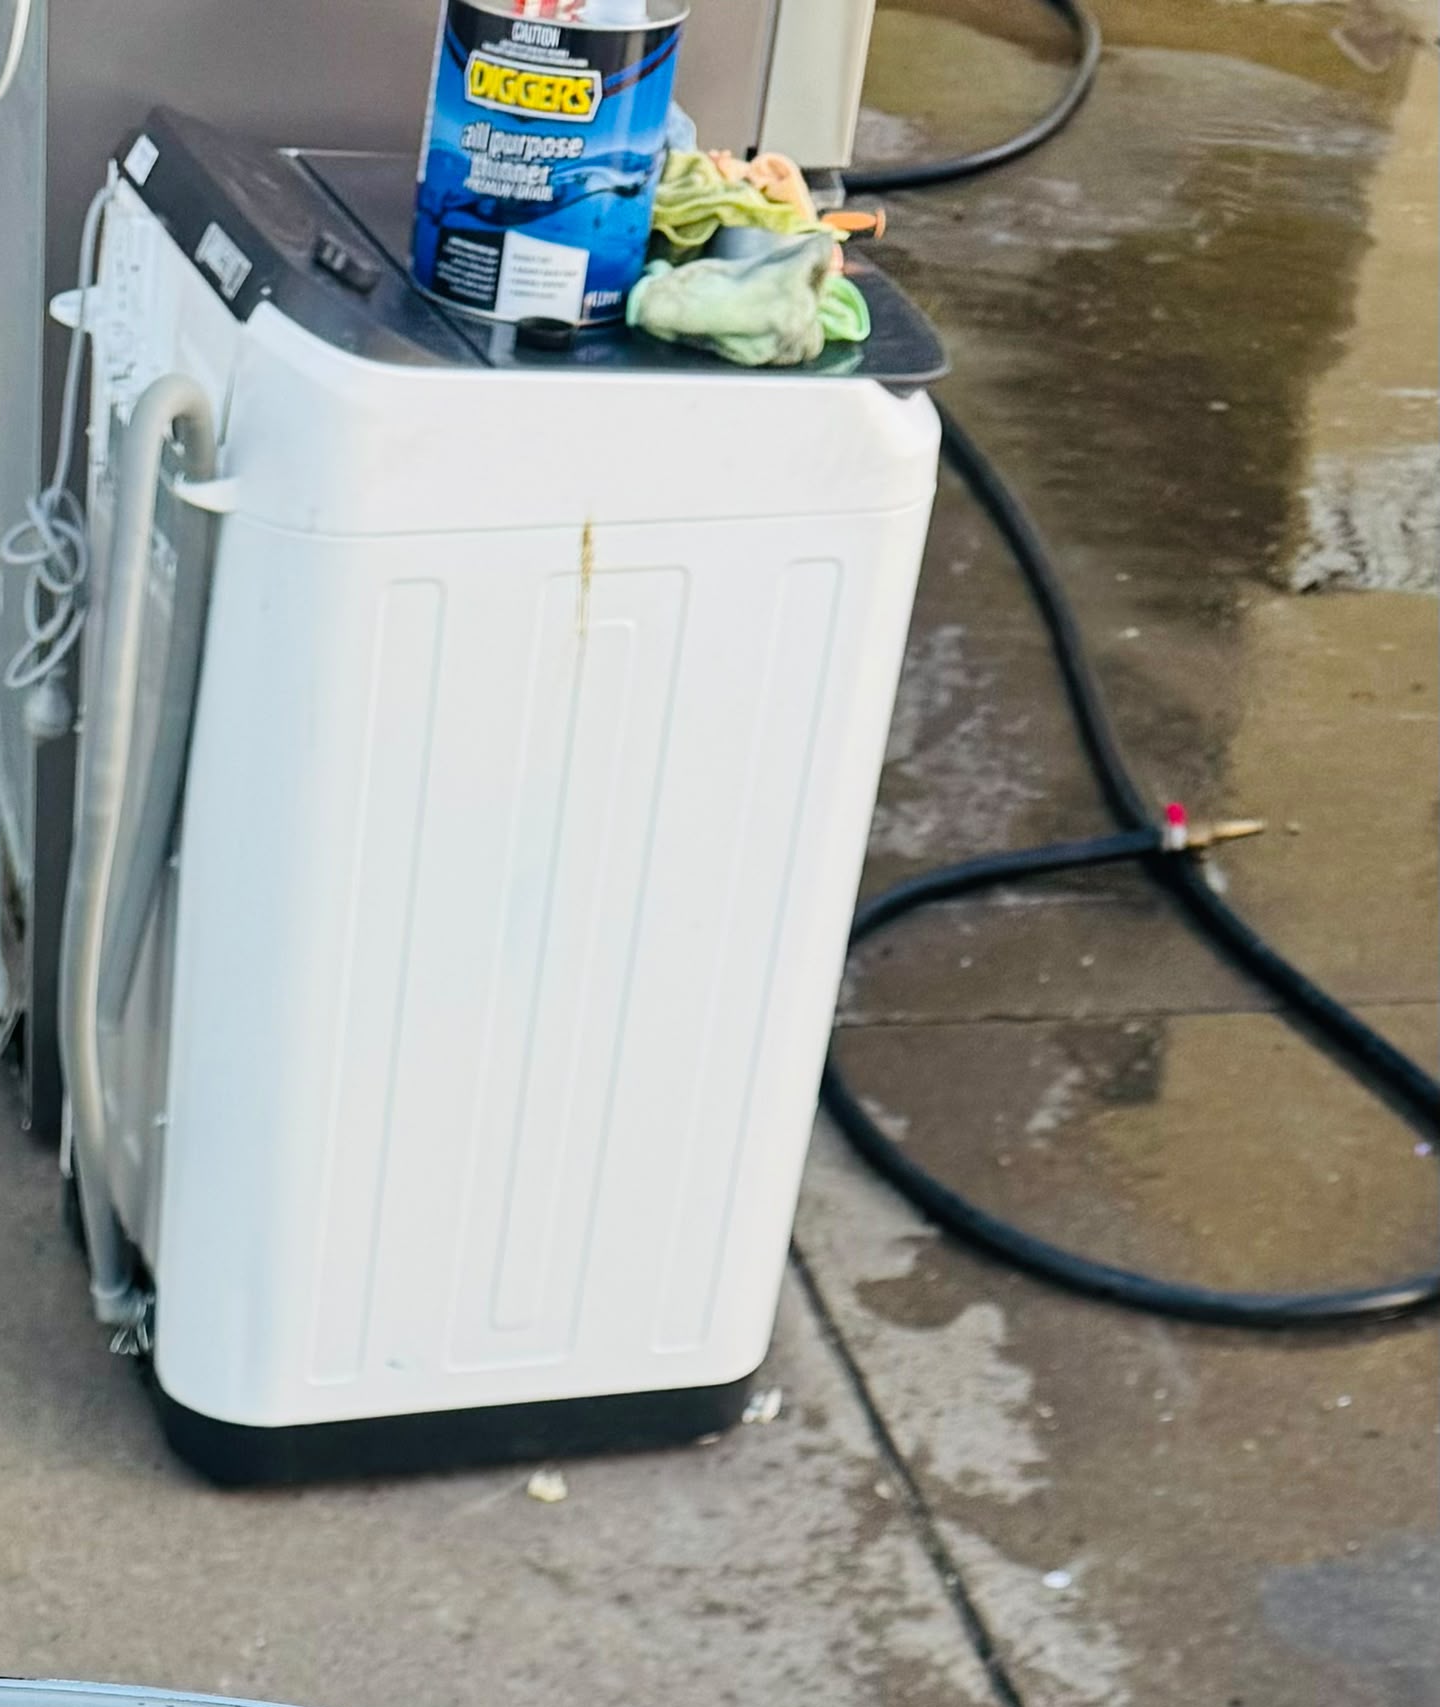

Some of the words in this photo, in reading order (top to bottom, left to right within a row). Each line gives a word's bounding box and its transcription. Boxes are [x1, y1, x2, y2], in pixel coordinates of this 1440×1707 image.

[470, 60, 594, 115] DIGGERS
[462, 123, 490, 150] all
[488, 131, 584, 160] purpose
